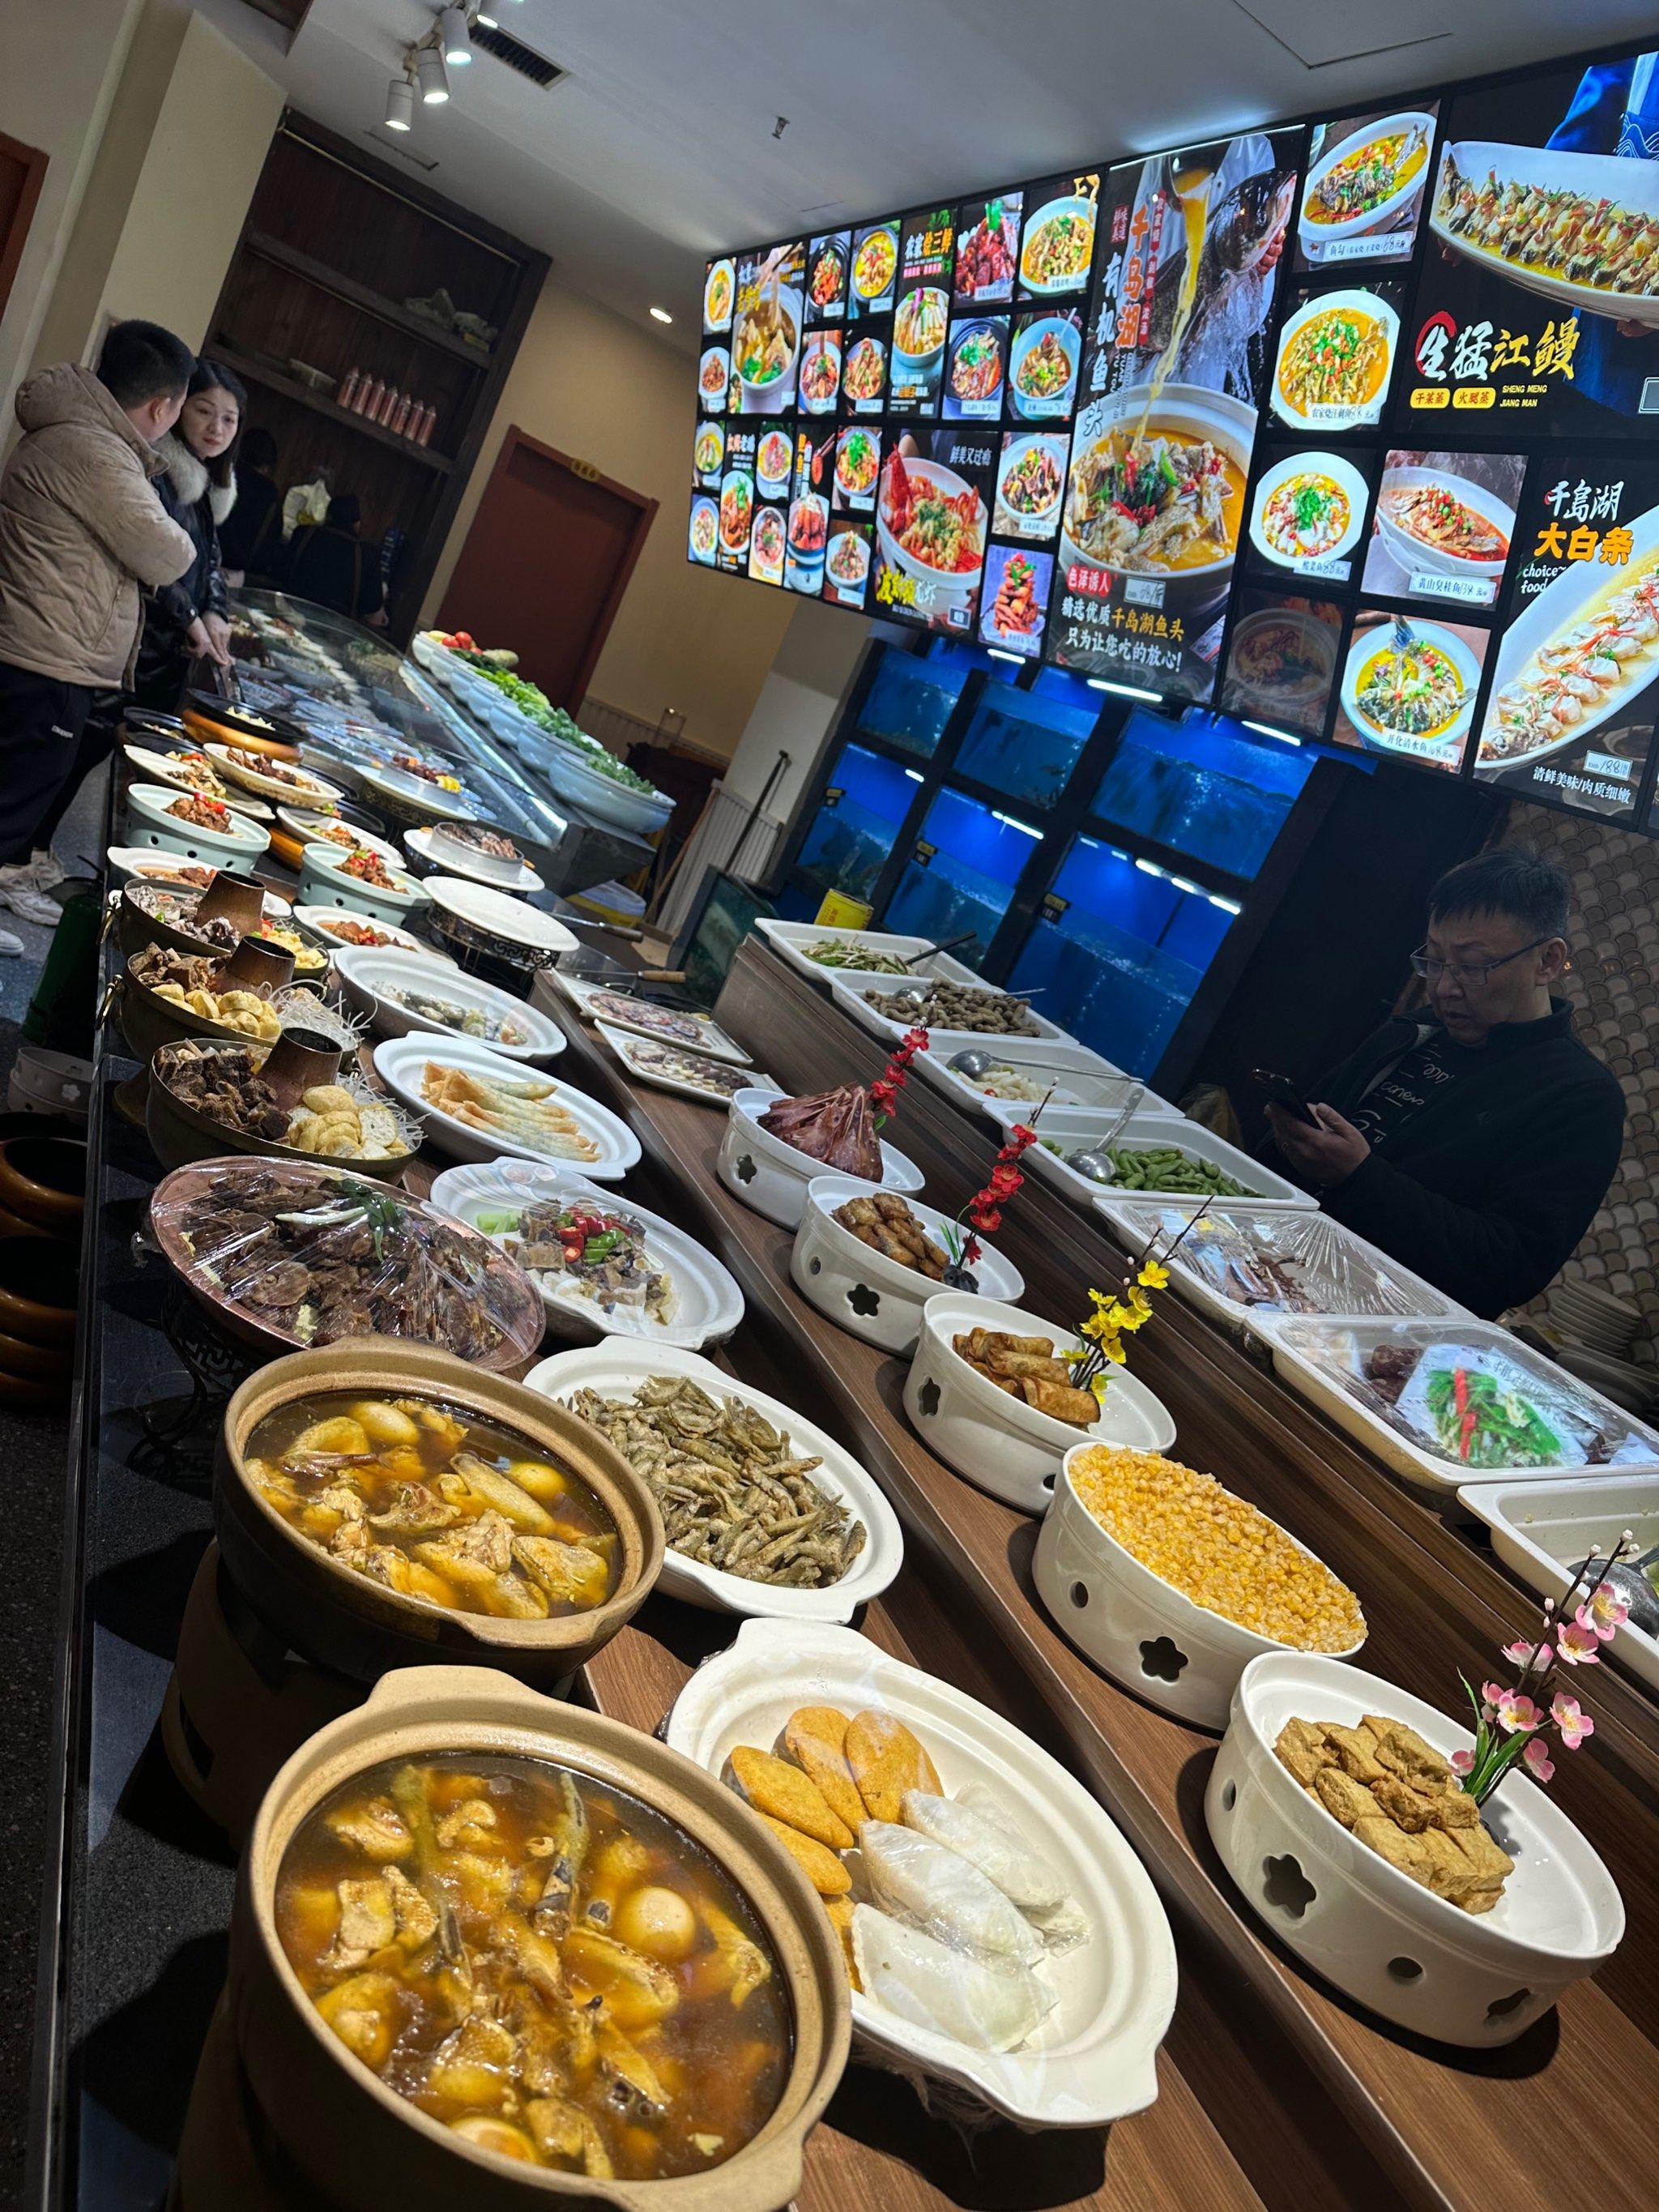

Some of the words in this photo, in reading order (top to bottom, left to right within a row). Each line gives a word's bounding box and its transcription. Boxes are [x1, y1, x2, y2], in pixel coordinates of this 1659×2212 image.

[1082, 251, 1122, 438] 有机鱼头
[1416, 316, 1580, 382] 生猛江鳗
[1499, 399, 1520, 408] JIANG
[1521, 399, 1538, 408] MAN
[1502, 385, 1525, 394] SHENG
[1526, 385, 1548, 394] MENG
[1533, 522, 1635, 566] 大白条
[1068, 567, 1111, 595] 色泽诱人
[1520, 578, 1549, 594] food
[1061, 596, 1185, 642] 精选优质千岛湖鱼头
[1533, 766, 1631, 805] 清鲜美味/肉质细嫩
